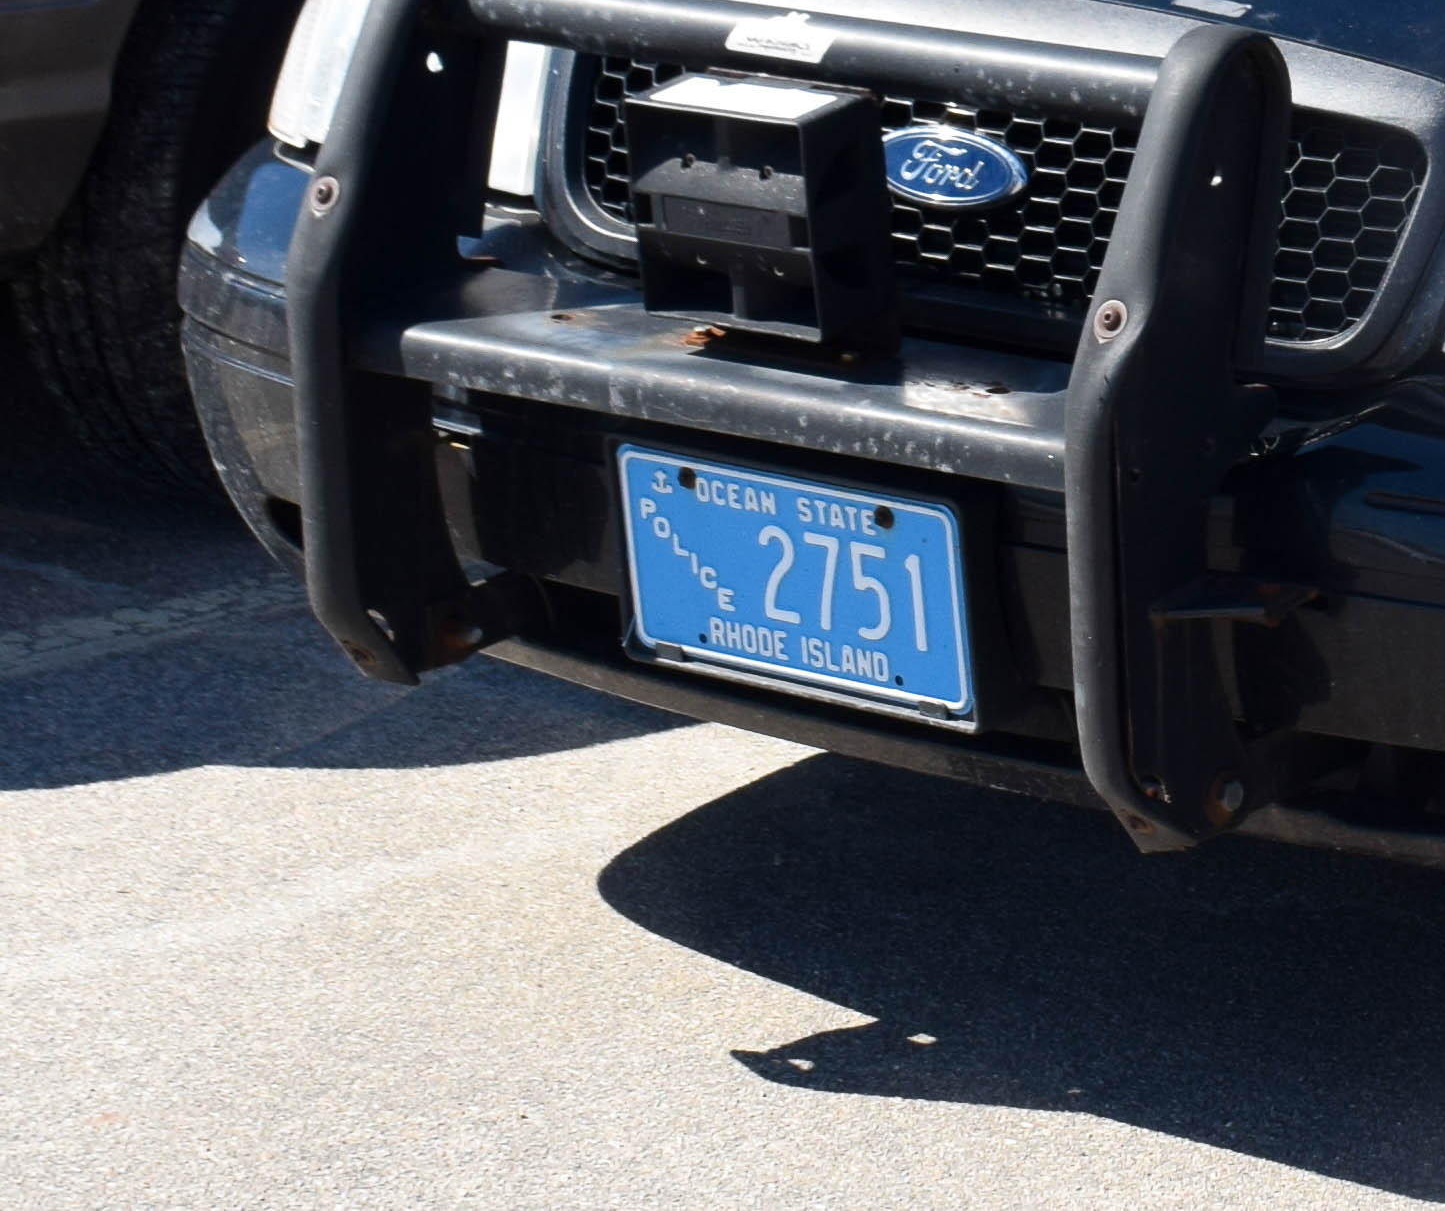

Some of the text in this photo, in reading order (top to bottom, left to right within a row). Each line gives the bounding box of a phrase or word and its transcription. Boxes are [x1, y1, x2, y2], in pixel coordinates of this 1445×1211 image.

[901, 140, 984, 189] Ford
[695, 476, 877, 536] OCEAN STATE
[640, 498, 736, 612] POLICE
[758, 524, 929, 652] 2751
[709, 617, 890, 683] RHODE ISLAND
